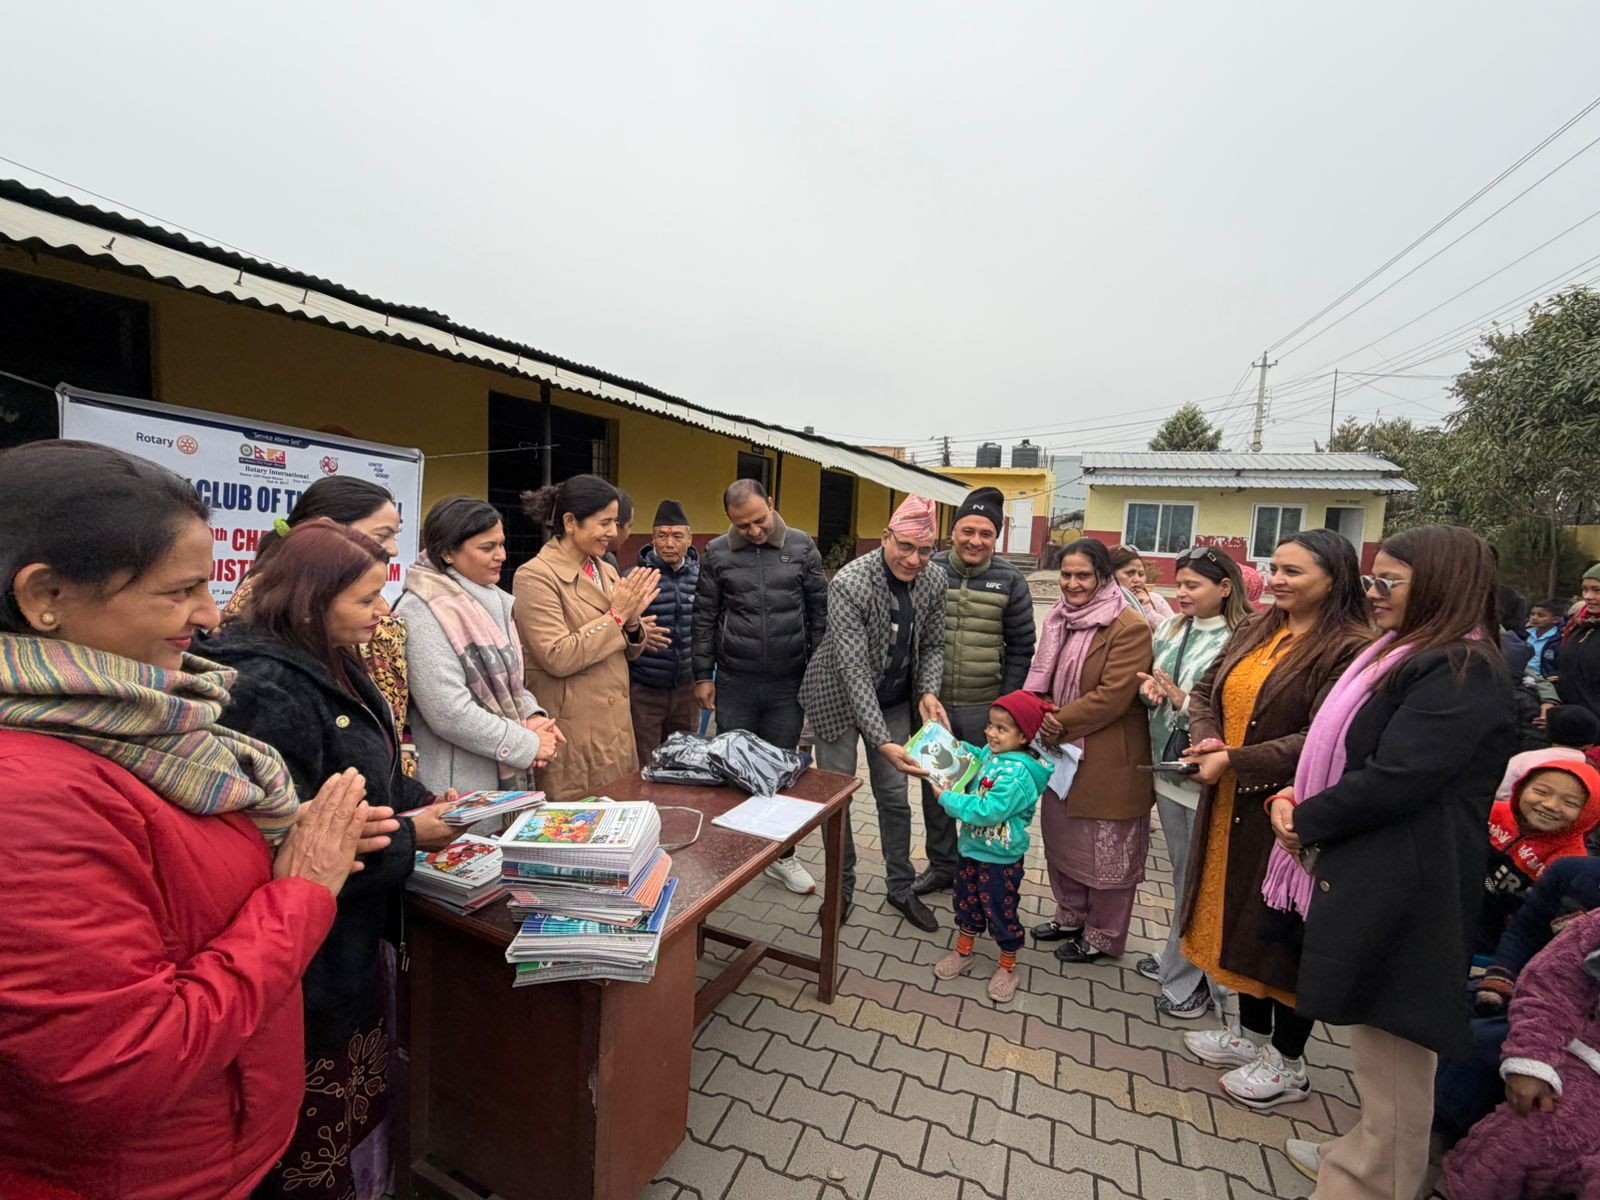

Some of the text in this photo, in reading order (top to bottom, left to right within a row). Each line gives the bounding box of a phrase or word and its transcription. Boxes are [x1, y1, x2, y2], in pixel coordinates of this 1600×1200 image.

[136, 431, 174, 448] Rotary
[245, 465, 269, 475] Rotary
[269, 468, 309, 480] International
[196, 479, 252, 511] CLUB
[257, 486, 281, 513] OF
[985, 581, 1002, 590] UFC
